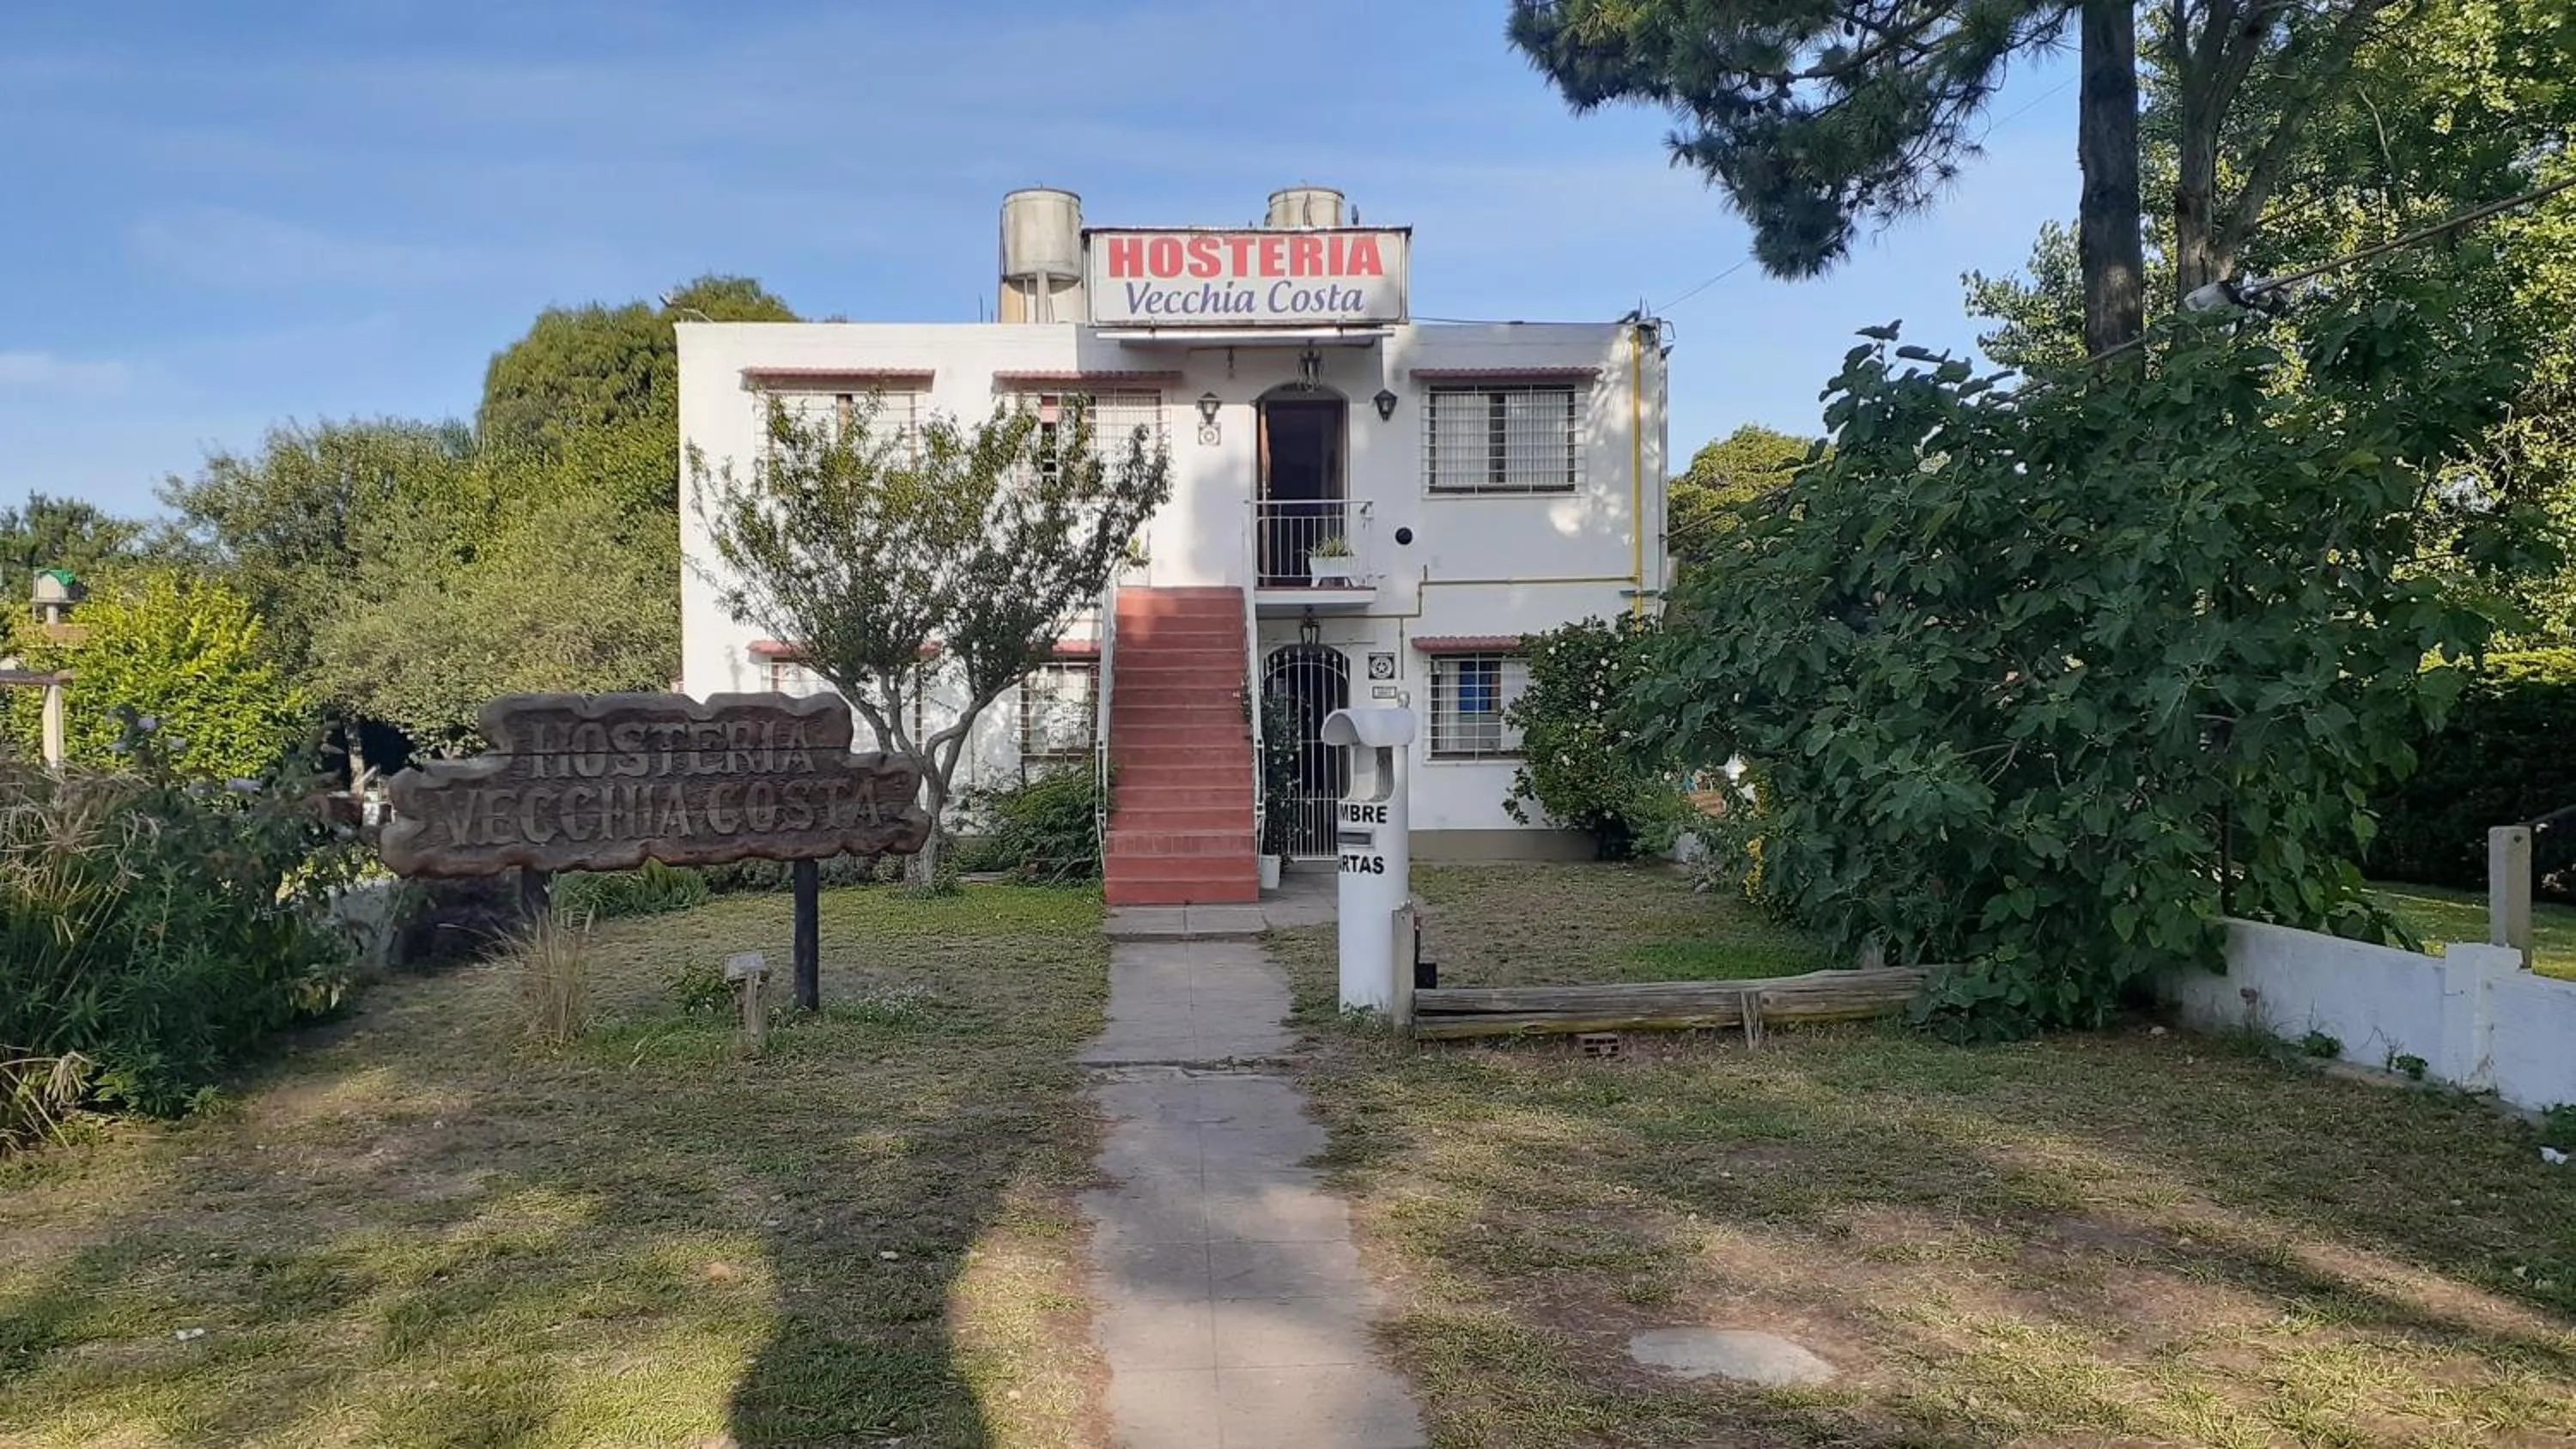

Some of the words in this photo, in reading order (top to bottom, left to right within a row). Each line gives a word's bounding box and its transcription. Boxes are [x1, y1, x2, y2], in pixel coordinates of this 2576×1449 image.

[1108, 236, 1384, 278] HOSTERIA
[1125, 281, 1255, 315] Vecchia
[1267, 279, 1365, 313] Costa
[527, 718, 817, 779] HOSTERIA
[434, 781, 694, 846] VECCHIA
[707, 776, 884, 834] COSTA
